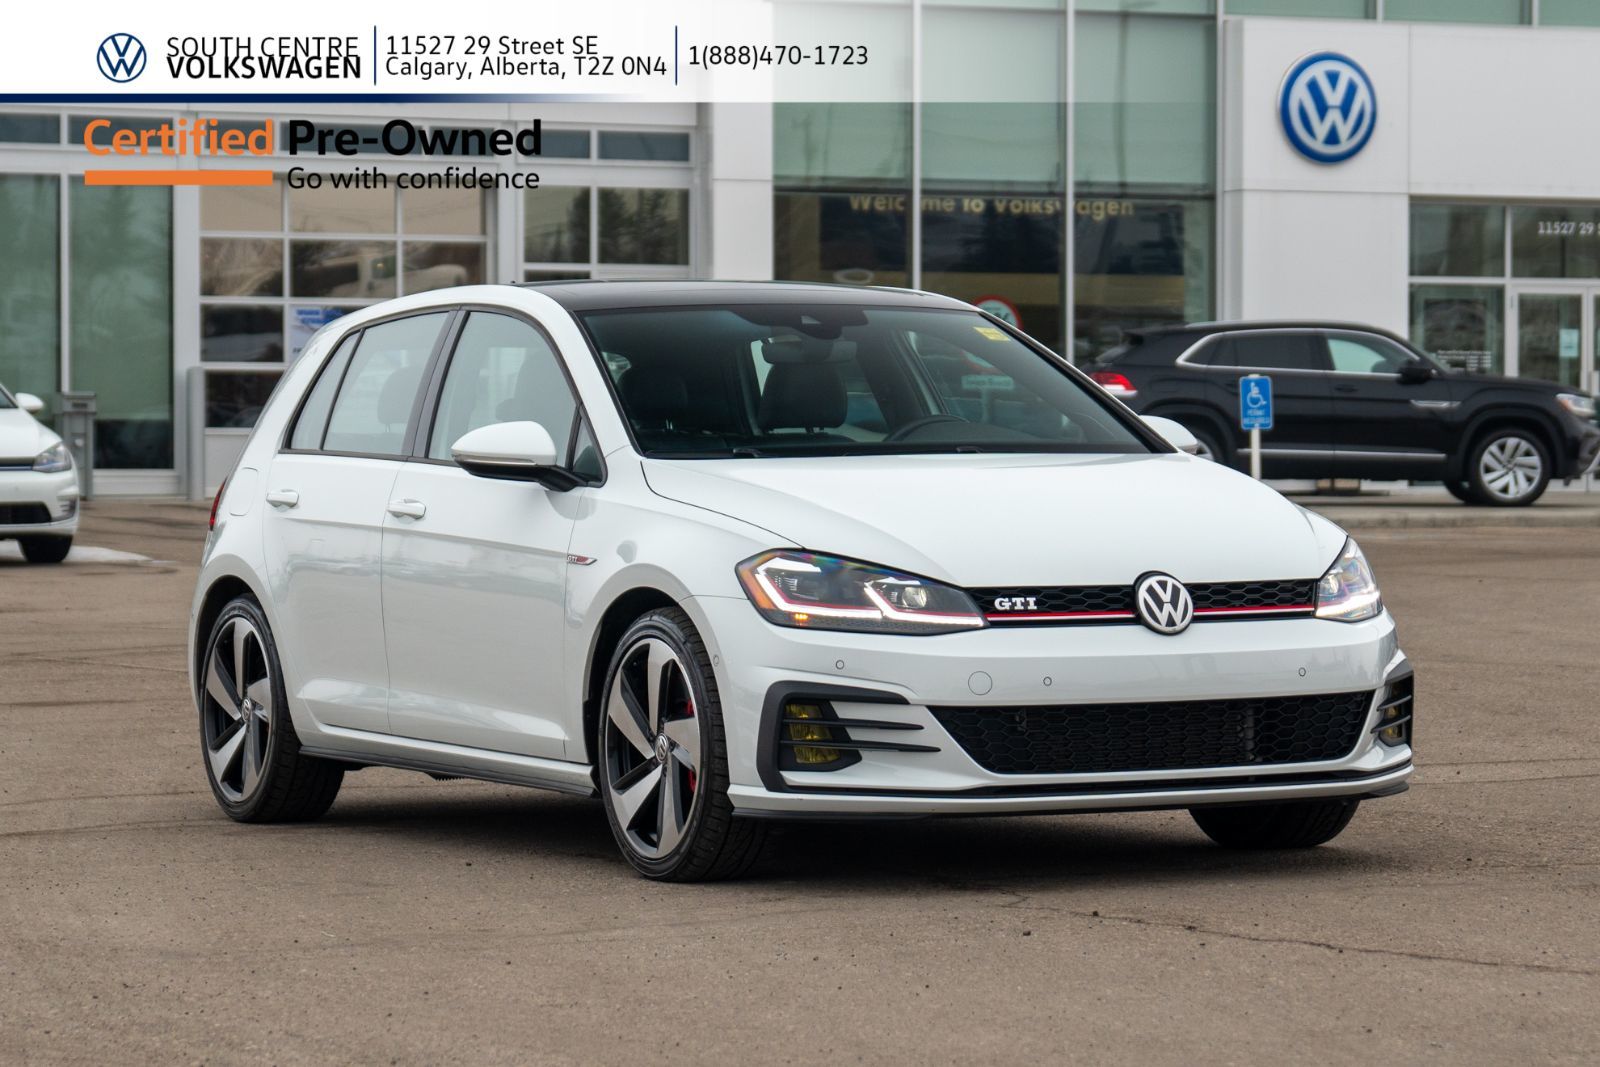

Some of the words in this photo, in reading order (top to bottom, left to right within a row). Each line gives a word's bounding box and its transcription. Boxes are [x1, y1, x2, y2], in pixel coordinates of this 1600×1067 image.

[849, 194, 957, 212] Welcme
[994, 198, 1135, 221] Volksagen
[1538, 220, 1576, 234] 11527
[1579, 221, 1595, 235] 29
[994, 597, 1038, 610] GTI
